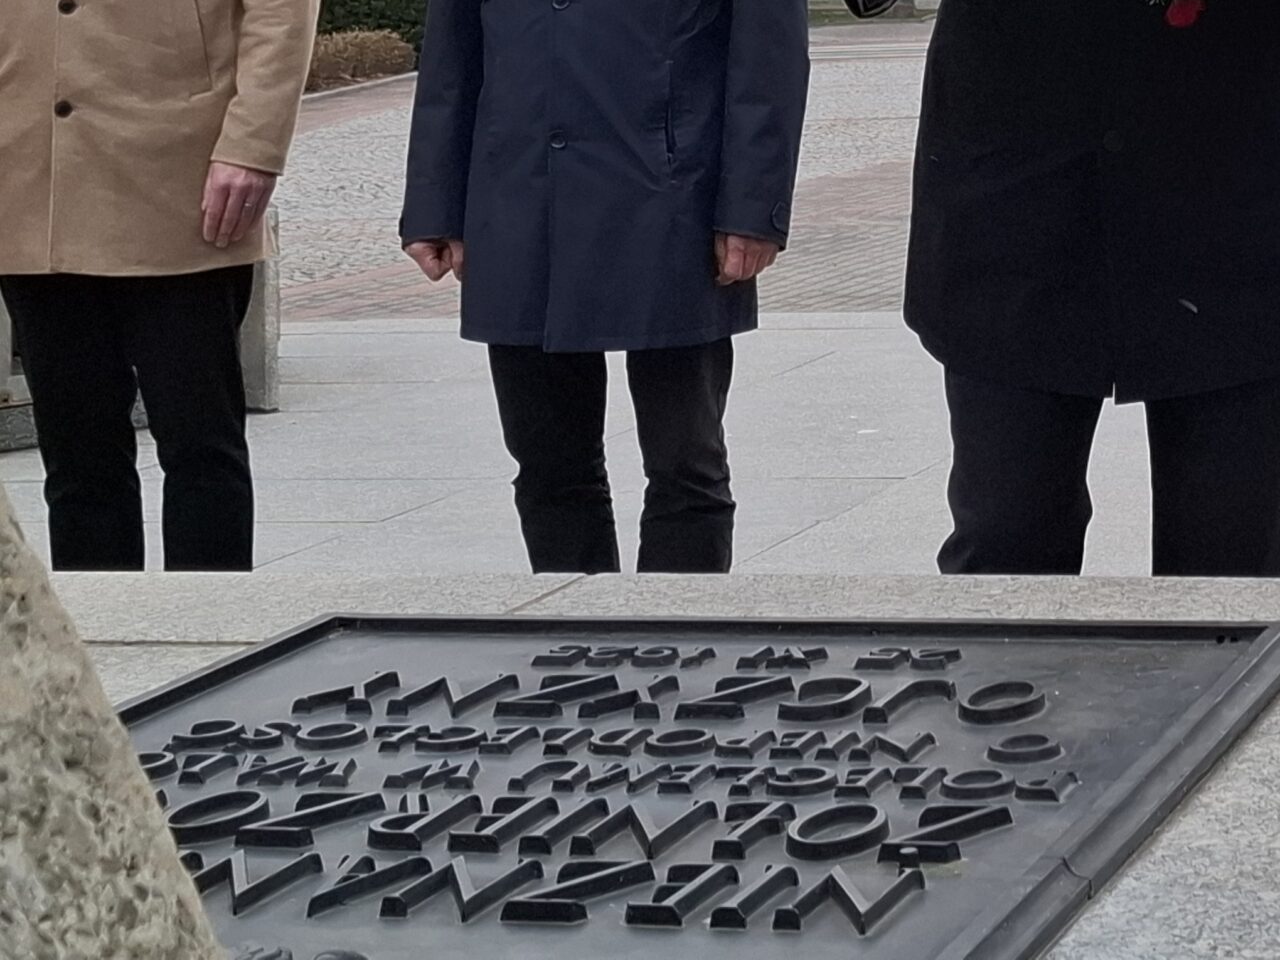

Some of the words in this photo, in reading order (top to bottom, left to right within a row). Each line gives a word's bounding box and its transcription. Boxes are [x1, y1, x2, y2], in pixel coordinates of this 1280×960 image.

[291, 671, 1046, 725] OJCZYZNY
[162, 719, 937, 763] NIEPODLEGŁOŚĆ
[986, 733, 1064, 763] O
[138, 751, 358, 788] WALC
[383, 758, 481, 790] W
[507, 760, 1079, 803] POLEGŁEMU
[156, 788, 1015, 869] ŻOŁNIERZO
[178, 849, 926, 937] NIEZNAN
